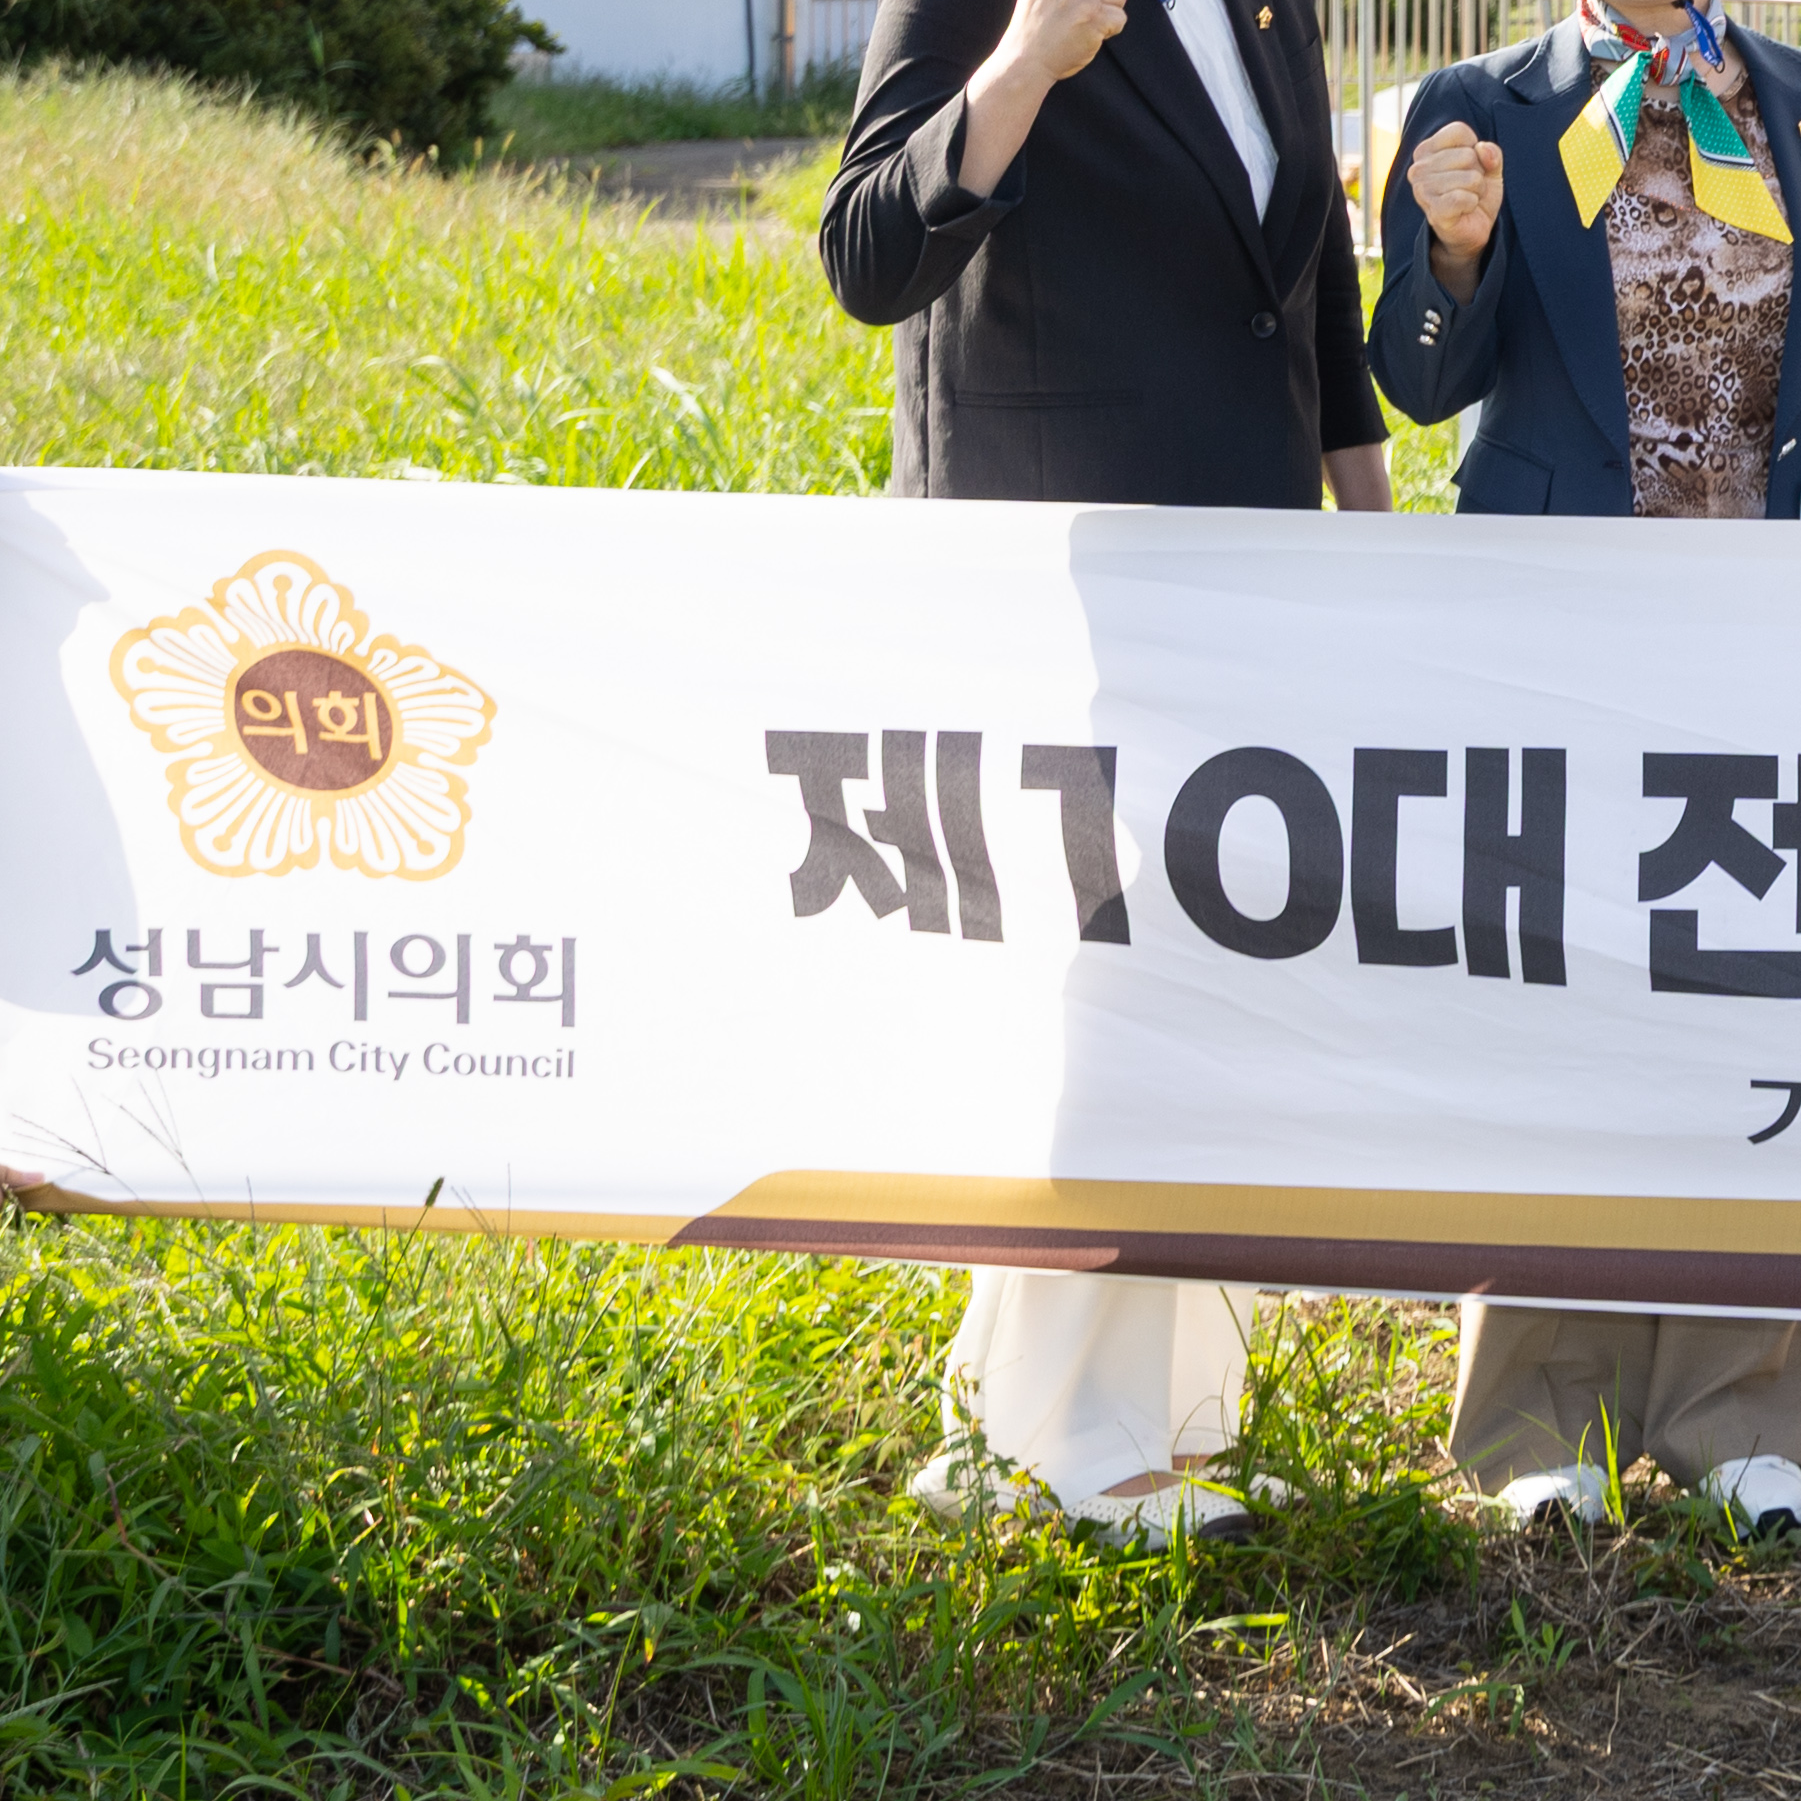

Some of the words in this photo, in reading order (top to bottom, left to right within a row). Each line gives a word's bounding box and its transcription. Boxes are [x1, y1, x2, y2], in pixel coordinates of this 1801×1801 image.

[241, 689, 382, 760] 의회
[765, 730, 1567, 987] 제10대
[71, 928, 576, 1027] 성남시의회
[87, 1037, 315, 1079] Seongnam
[329, 1040, 409, 1081] City
[423, 1042, 576, 1079] Council
